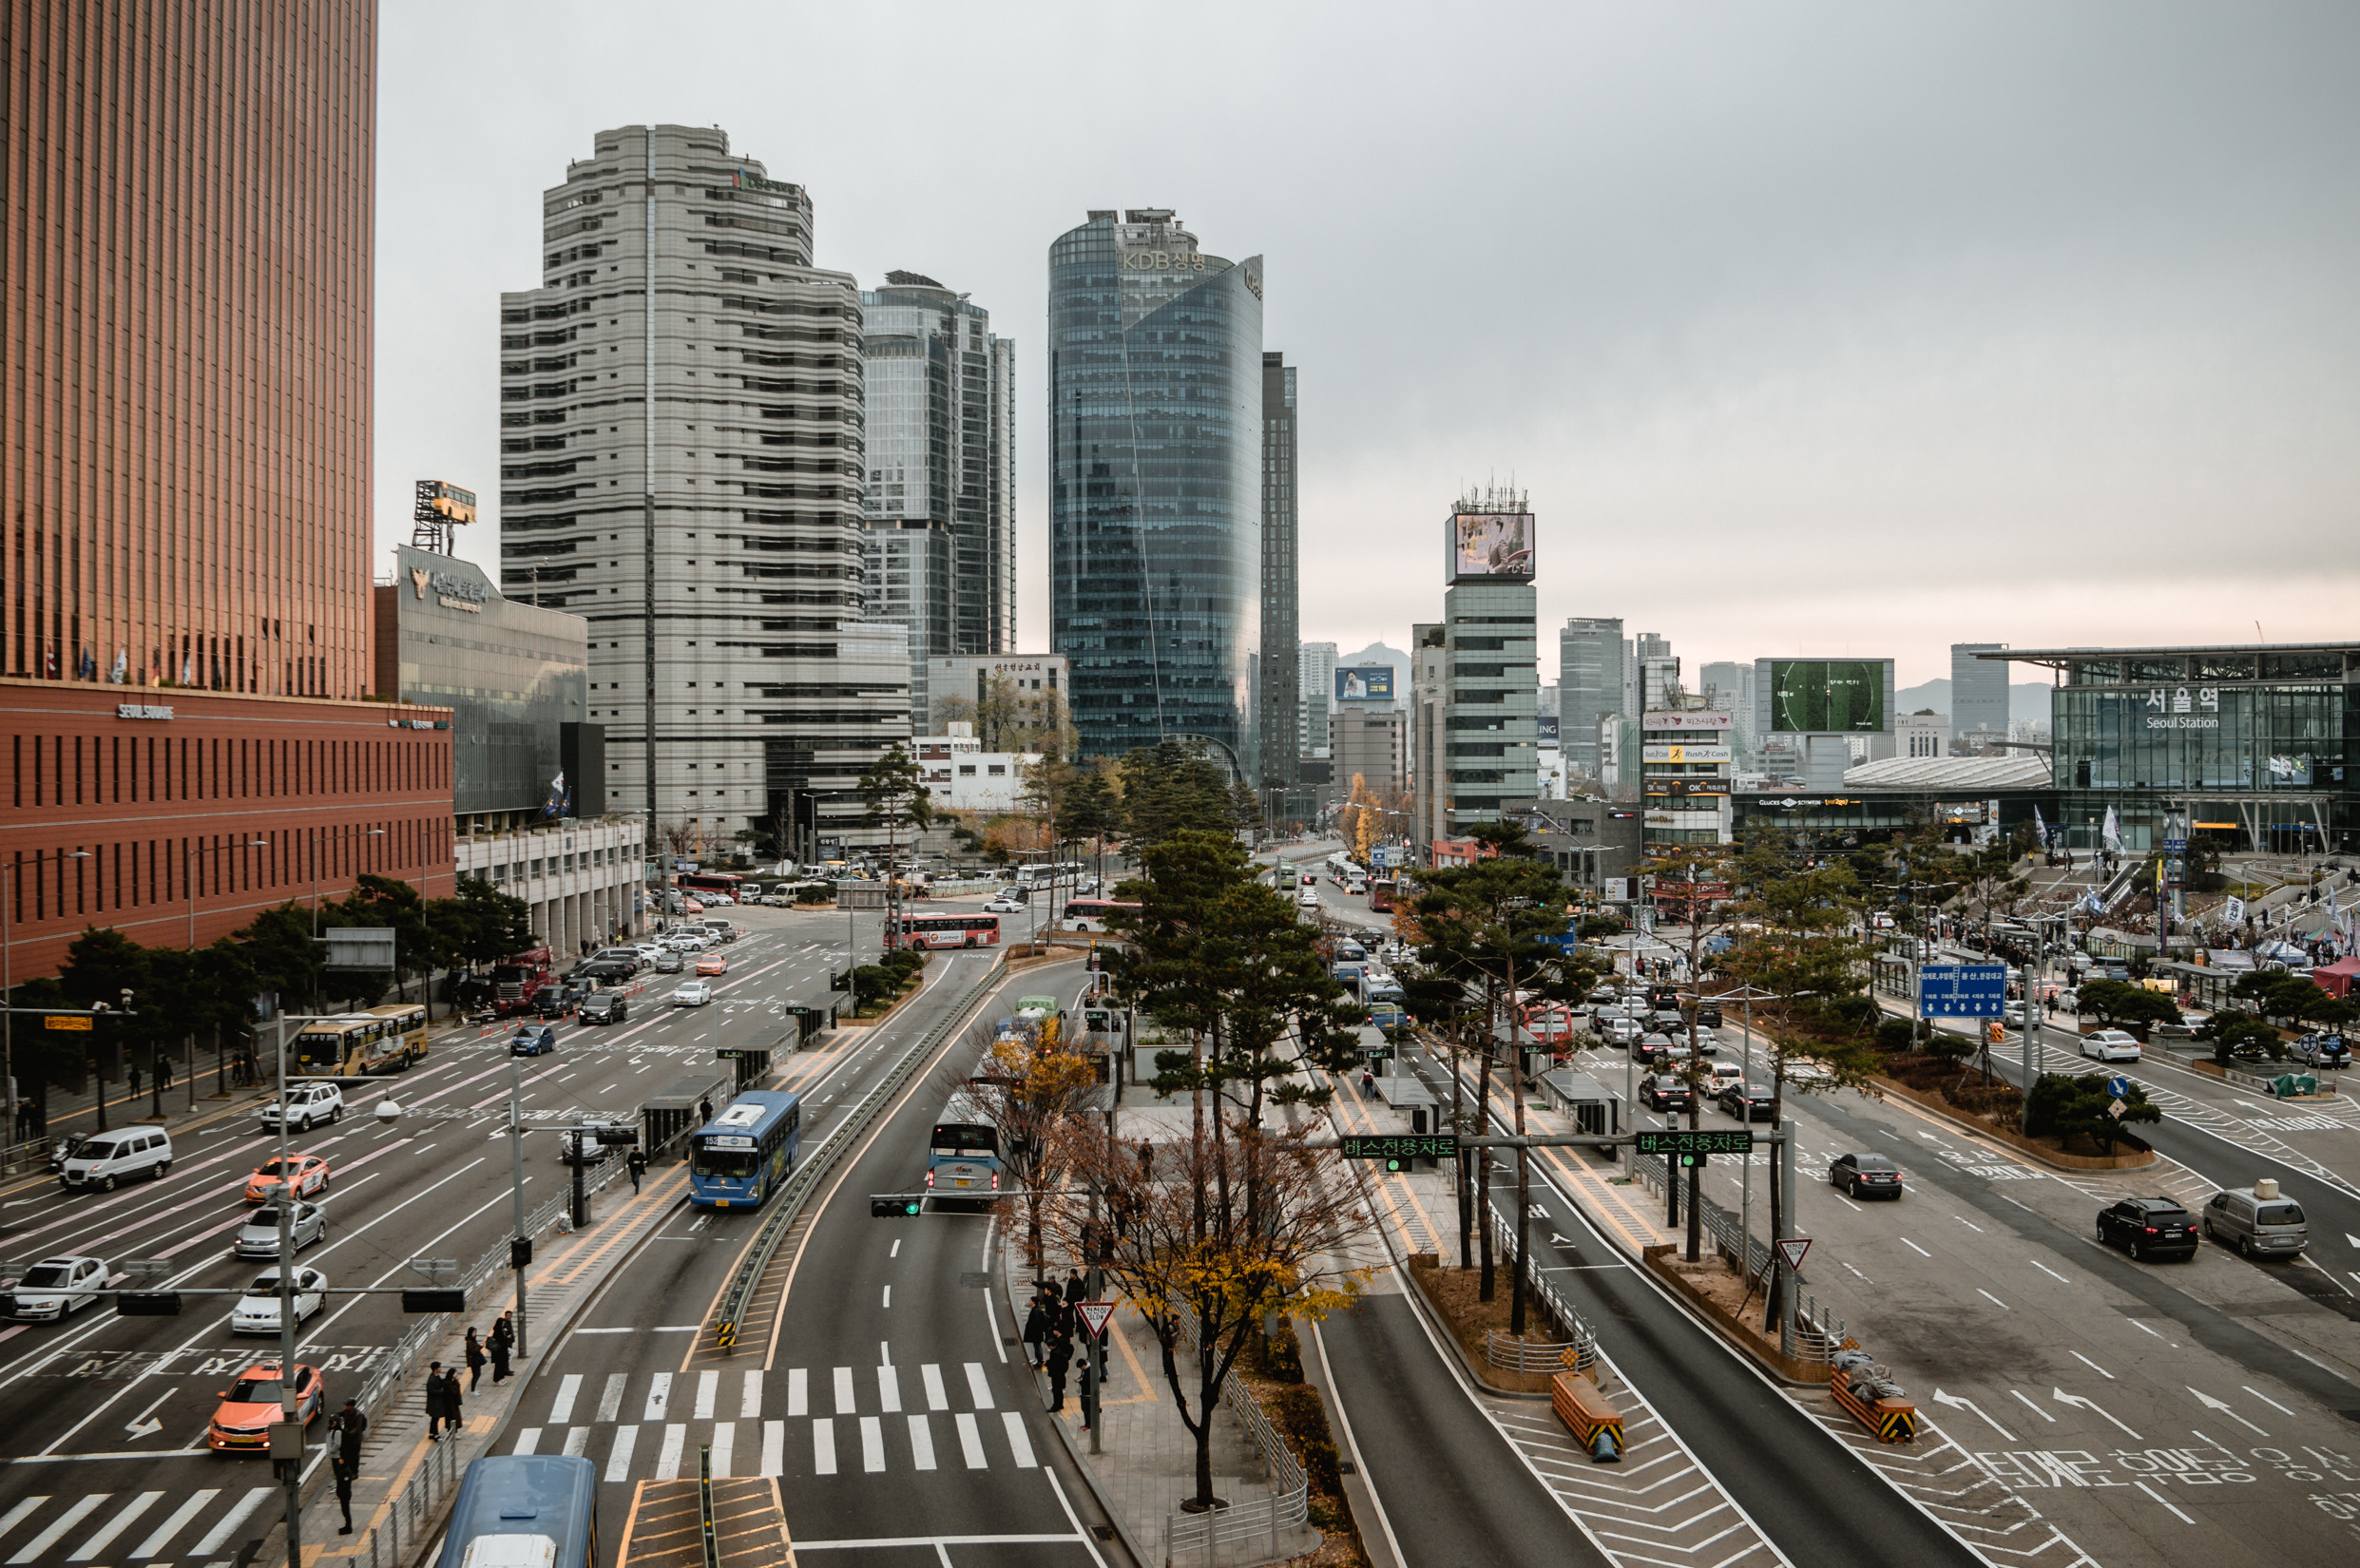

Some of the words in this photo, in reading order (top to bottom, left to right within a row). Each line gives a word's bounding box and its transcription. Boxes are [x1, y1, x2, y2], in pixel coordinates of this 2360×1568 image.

[1123, 253, 1205, 272] KDB생명
[2146, 686, 2218, 713] 서울역
[2146, 717, 2178, 729] Seoul
[2178, 717, 2219, 729] Station
[574, 1133, 580, 1141] 7
[705, 1136, 718, 1145] 152
[1641, 1134, 1749, 1152] 버스전용차로
[1345, 1138, 1455, 1157] 버스전용차로
[1939, 1150, 2005, 1164] 용산
[1973, 1449, 2130, 1488] 퇴계로
[2108, 1448, 2256, 1485] 후암동
